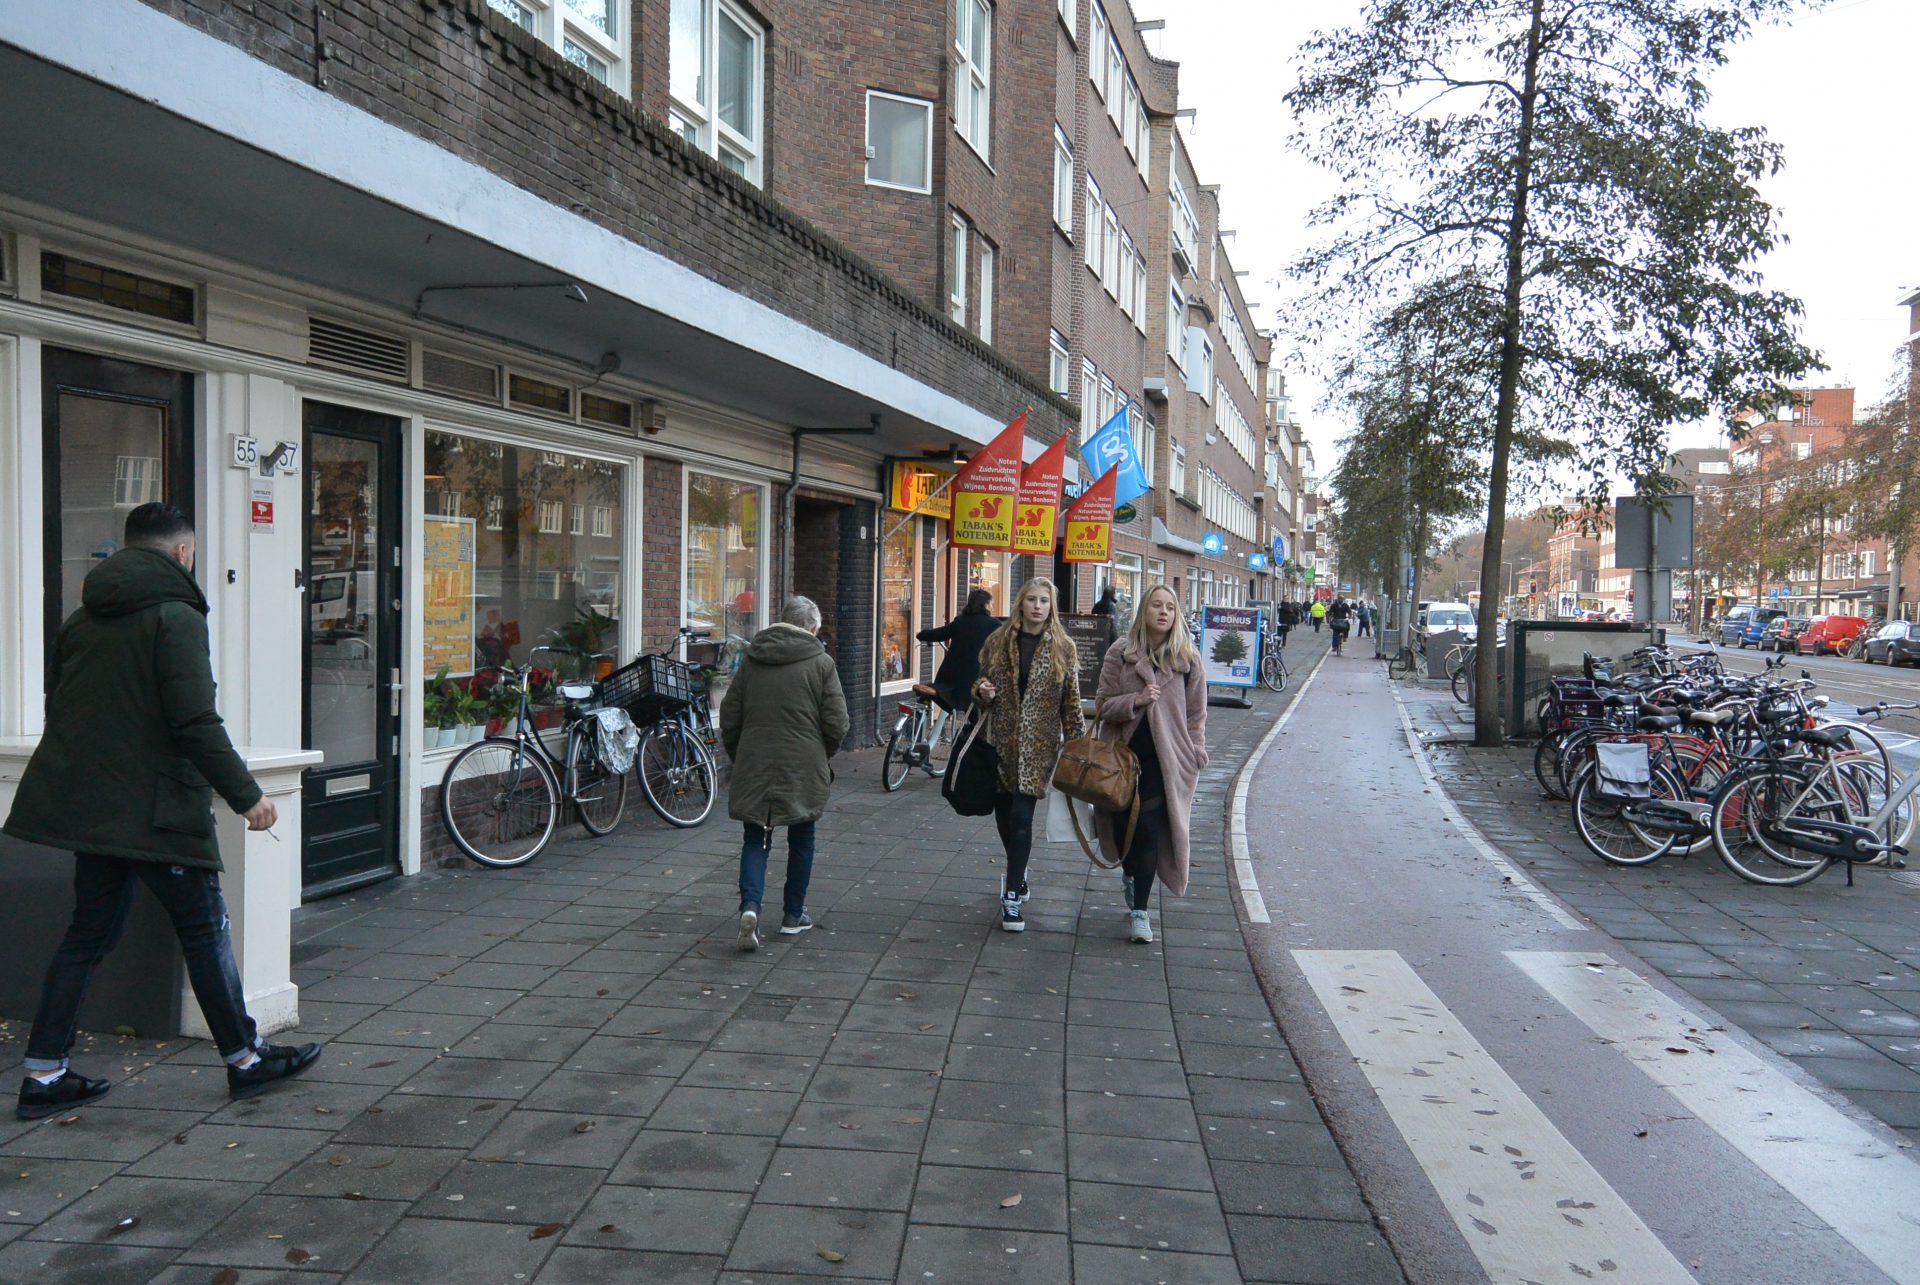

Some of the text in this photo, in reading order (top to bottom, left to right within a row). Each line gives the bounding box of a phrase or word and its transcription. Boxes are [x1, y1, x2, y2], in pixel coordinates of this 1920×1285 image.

[237, 440, 256, 462] 55
[979, 465, 1017, 474] Zuidvruchten
[970, 474, 1016, 484] Natuurvoeding
[1024, 480, 1058, 488] Zuidvruchten
[964, 483, 1015, 492] Wijnen, Bonbons
[962, 520, 1004, 531] TABAK'S
[955, 530, 1009, 541] NOTENBAR
[1220, 615, 1251, 625] BONUS
